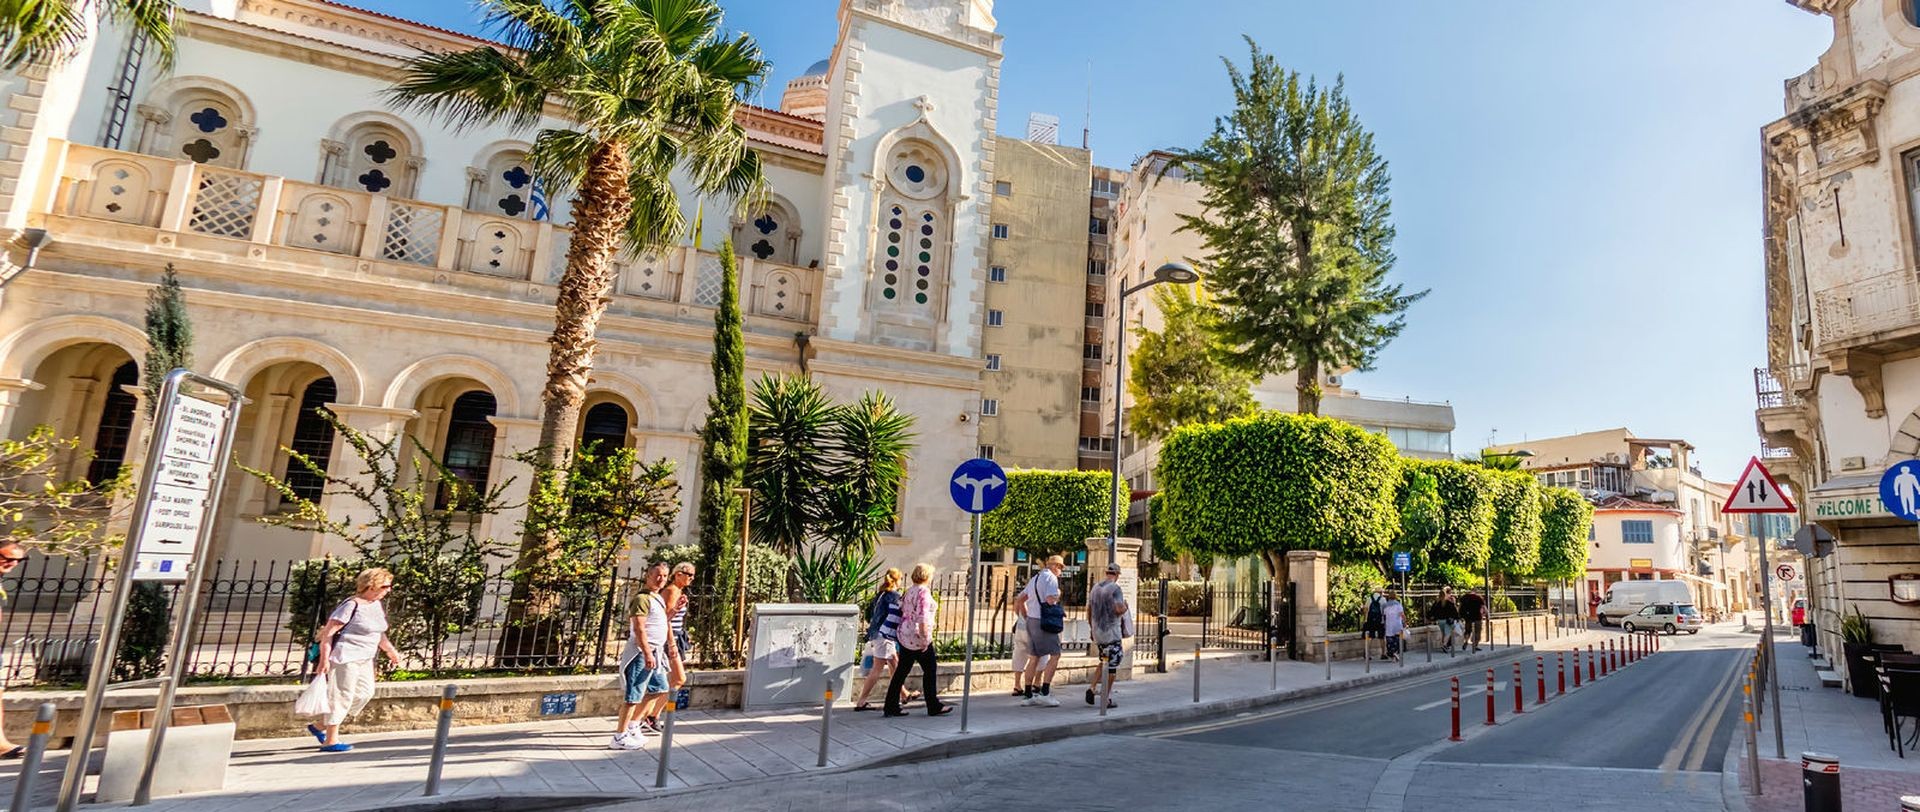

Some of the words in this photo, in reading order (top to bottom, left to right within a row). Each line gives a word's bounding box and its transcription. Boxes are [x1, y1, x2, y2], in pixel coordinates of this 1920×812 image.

[173, 447, 187, 456] TOWN
[188, 450, 201, 459] HALL
[170, 459, 191, 469] TOURIST
[169, 470, 199, 479] INFORMATION
[161, 495, 172, 503] OLD
[173, 497, 194, 505] MARKET
[158, 508, 172, 516] POST
[1816, 499, 1871, 516] WELCOME
